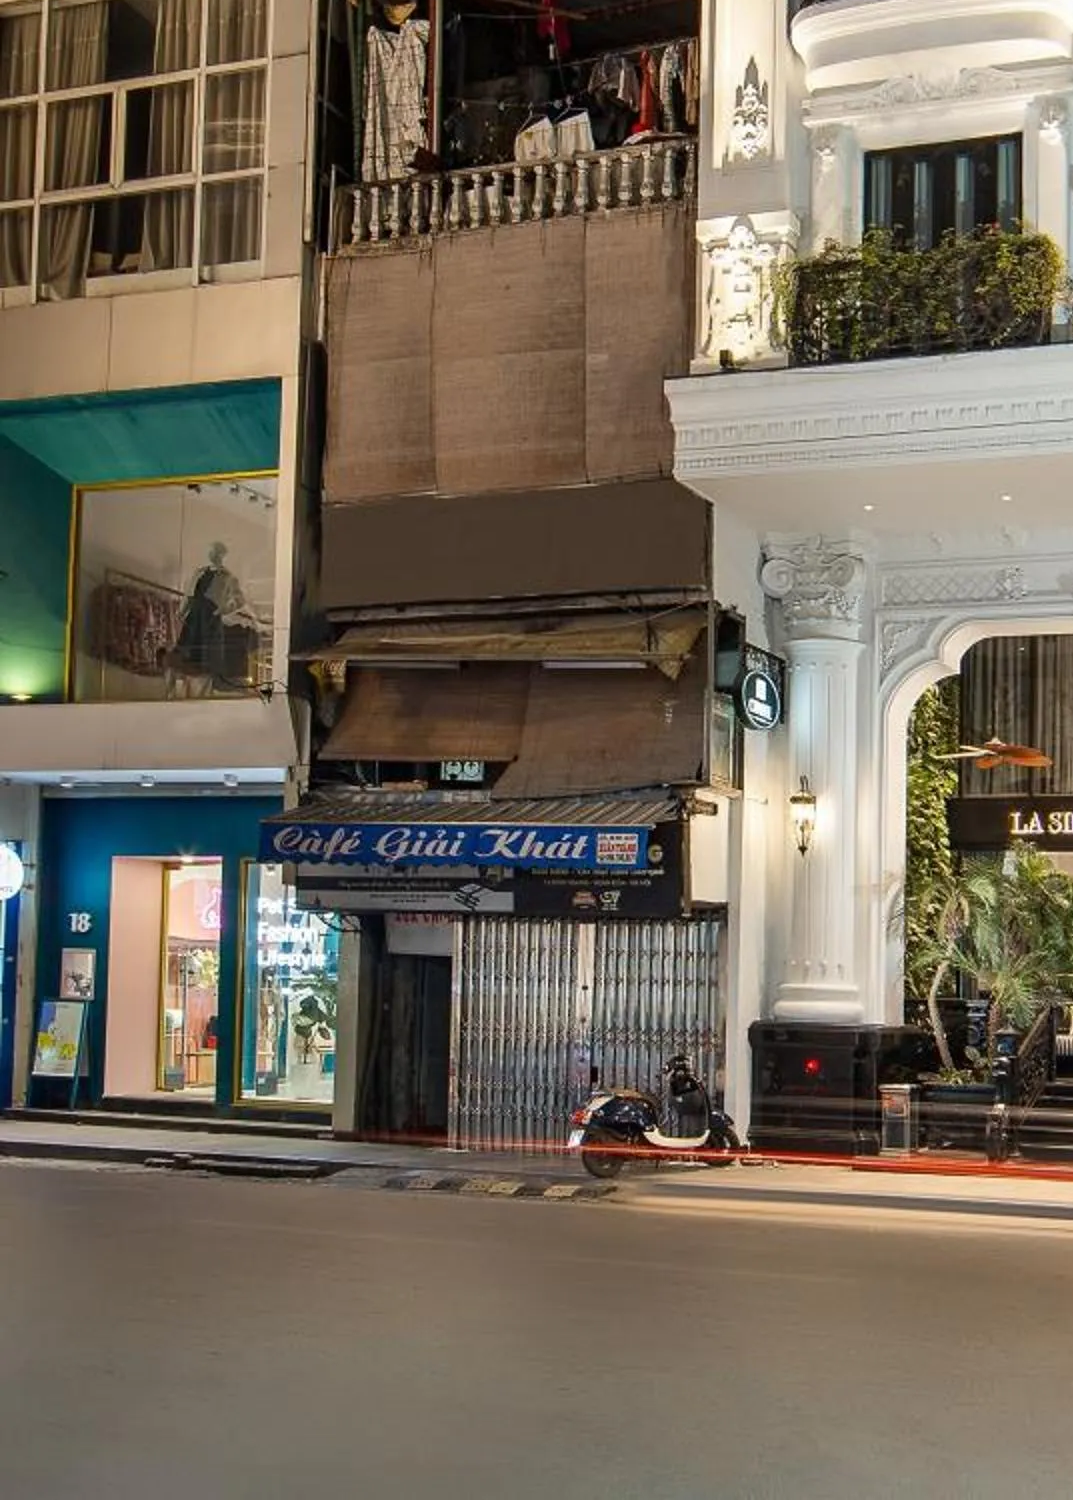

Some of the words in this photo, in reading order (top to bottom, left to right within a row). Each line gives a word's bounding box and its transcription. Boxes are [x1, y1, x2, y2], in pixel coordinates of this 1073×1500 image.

[1009, 811, 1044, 834] LA
[273, 826, 362, 860] Càfé
[372, 827, 465, 862] Giải
[474, 828, 589, 859] Khát
[68, 913, 92, 933] 18
[258, 920, 319, 942] Fashion
